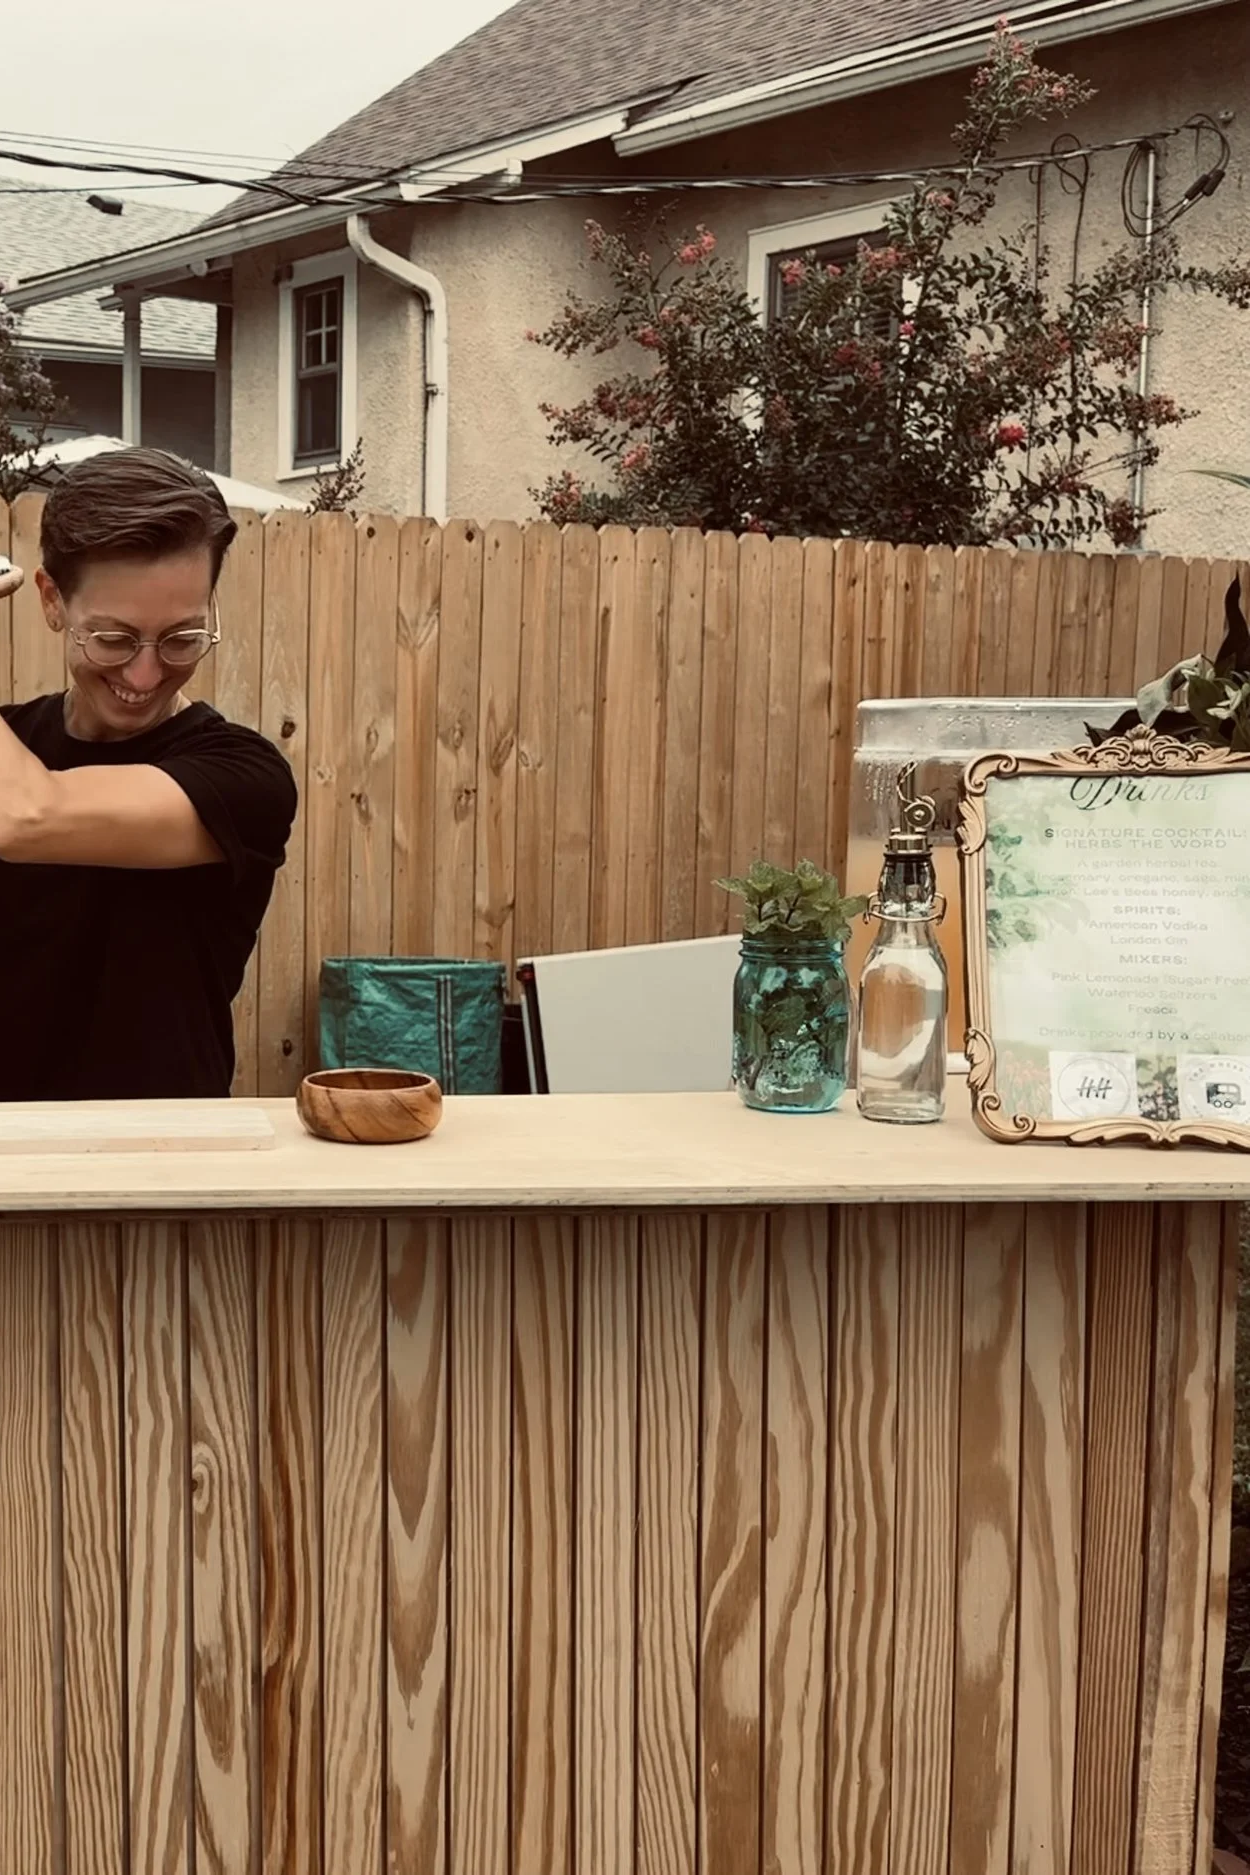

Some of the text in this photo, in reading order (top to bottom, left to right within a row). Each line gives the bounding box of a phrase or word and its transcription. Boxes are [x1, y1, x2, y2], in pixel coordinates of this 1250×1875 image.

[1069, 775, 1210, 811] Drinks
[1043, 827, 1146, 839] SIGNATURE
[1065, 839, 1228, 850] HERBS THE WORD
[1092, 858, 1142, 869] garden
[1145, 858, 1192, 868] herbal
[1213, 887, 1239, 898] and
[1112, 905, 1182, 916] SPIRITS:
[1089, 920, 1209, 931] American Vodka
[1109, 935, 1189, 945] London Gin
[1118, 954, 1188, 966] MIXERS:
[1050, 971, 1081, 982] Pink
[1085, 973, 1159, 985] Lemonade
[1086, 987, 1217, 1001] Waterloo Seltzers
[1038, 1026, 1086, 1038] Drinks
[1089, 1028, 1154, 1040] provided
[1157, 1028, 1176, 1042] by
[1179, 1031, 1190, 1041] a
